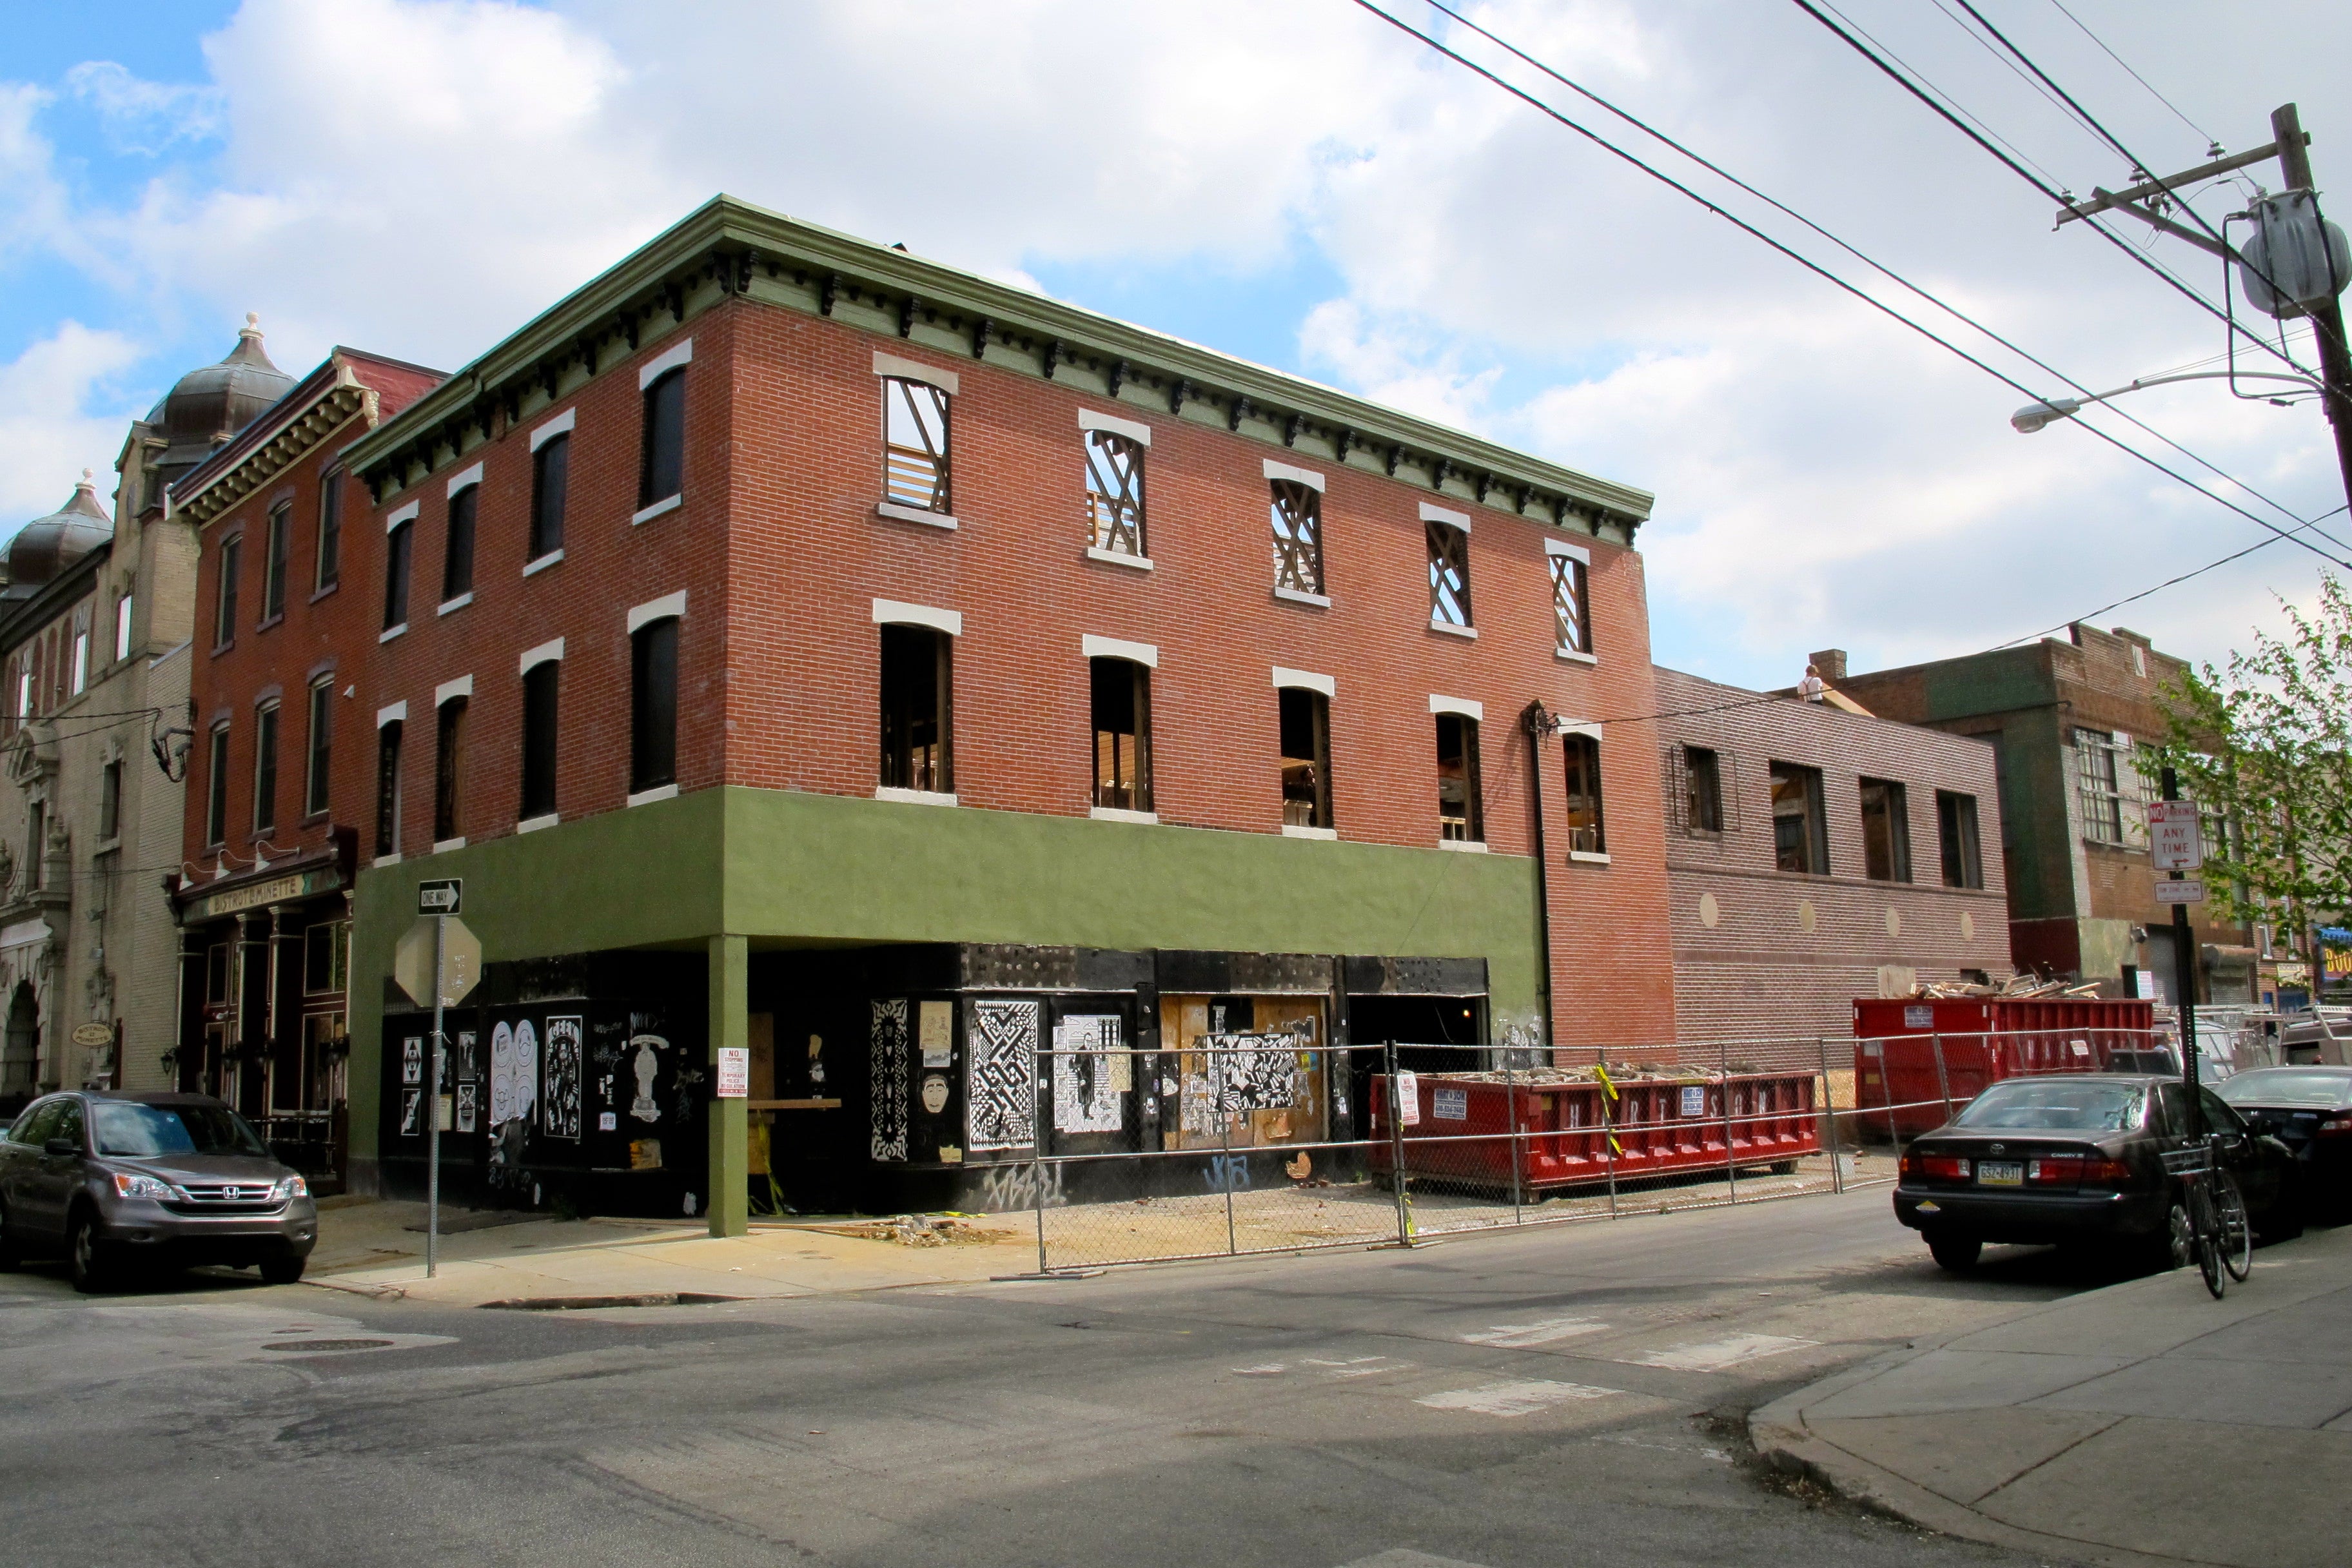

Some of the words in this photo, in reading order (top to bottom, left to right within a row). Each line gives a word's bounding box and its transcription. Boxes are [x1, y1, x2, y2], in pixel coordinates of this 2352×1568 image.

[2150, 807, 2164, 820] NO
[2164, 807, 2195, 817] PARKING
[2163, 828, 2186, 838] ANY
[2162, 843, 2190, 853] TIME
[214, 889, 248, 912] BISTROT
[257, 877, 297, 903] MINETTE
[422, 892, 435, 904] ONE
[435, 890, 448, 903] WAY
